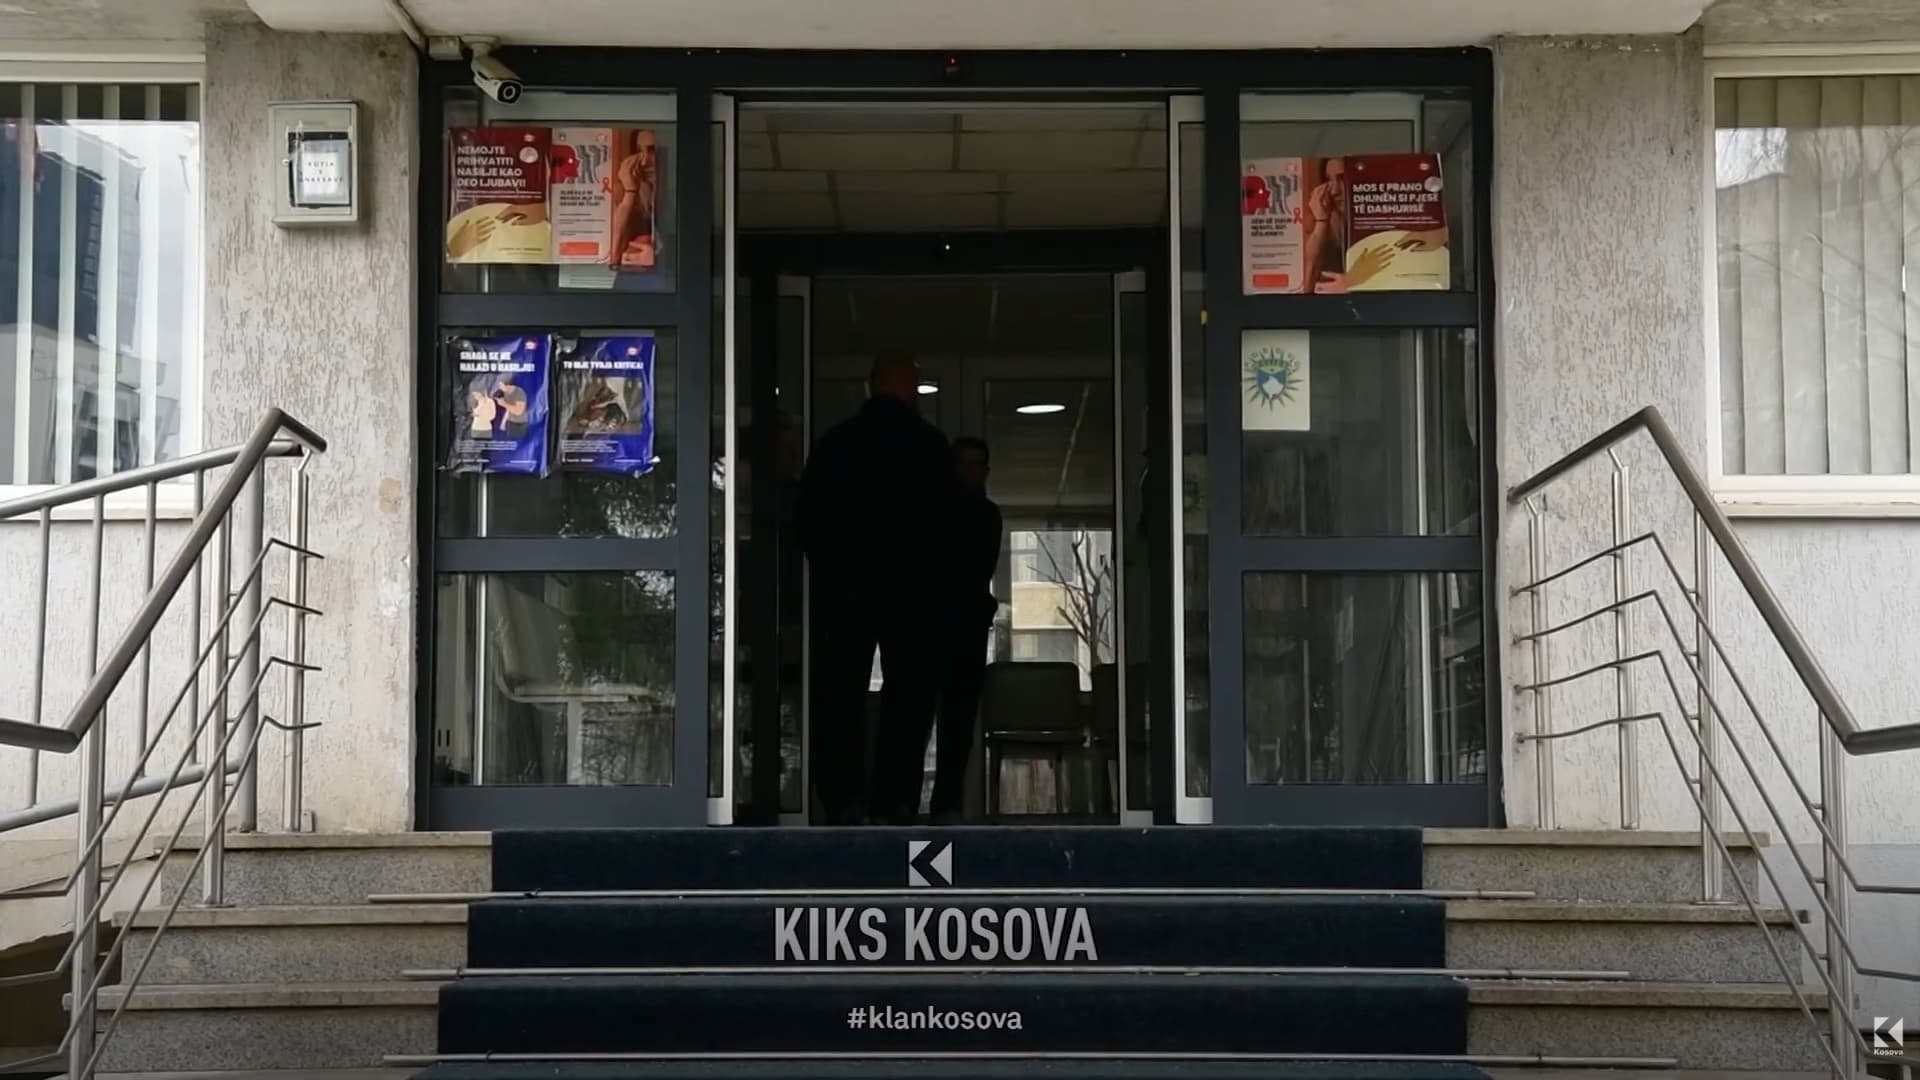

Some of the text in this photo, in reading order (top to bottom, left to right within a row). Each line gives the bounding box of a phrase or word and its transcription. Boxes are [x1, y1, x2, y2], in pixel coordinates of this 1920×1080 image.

[457, 146, 505, 155] NEMOJTE
[457, 156, 514, 166] PRIHVATITI
[457, 167, 523, 177] NASILJE KAO
[1353, 183, 1423, 192] MOS E PRANO
[1398, 193, 1408, 203] SI
